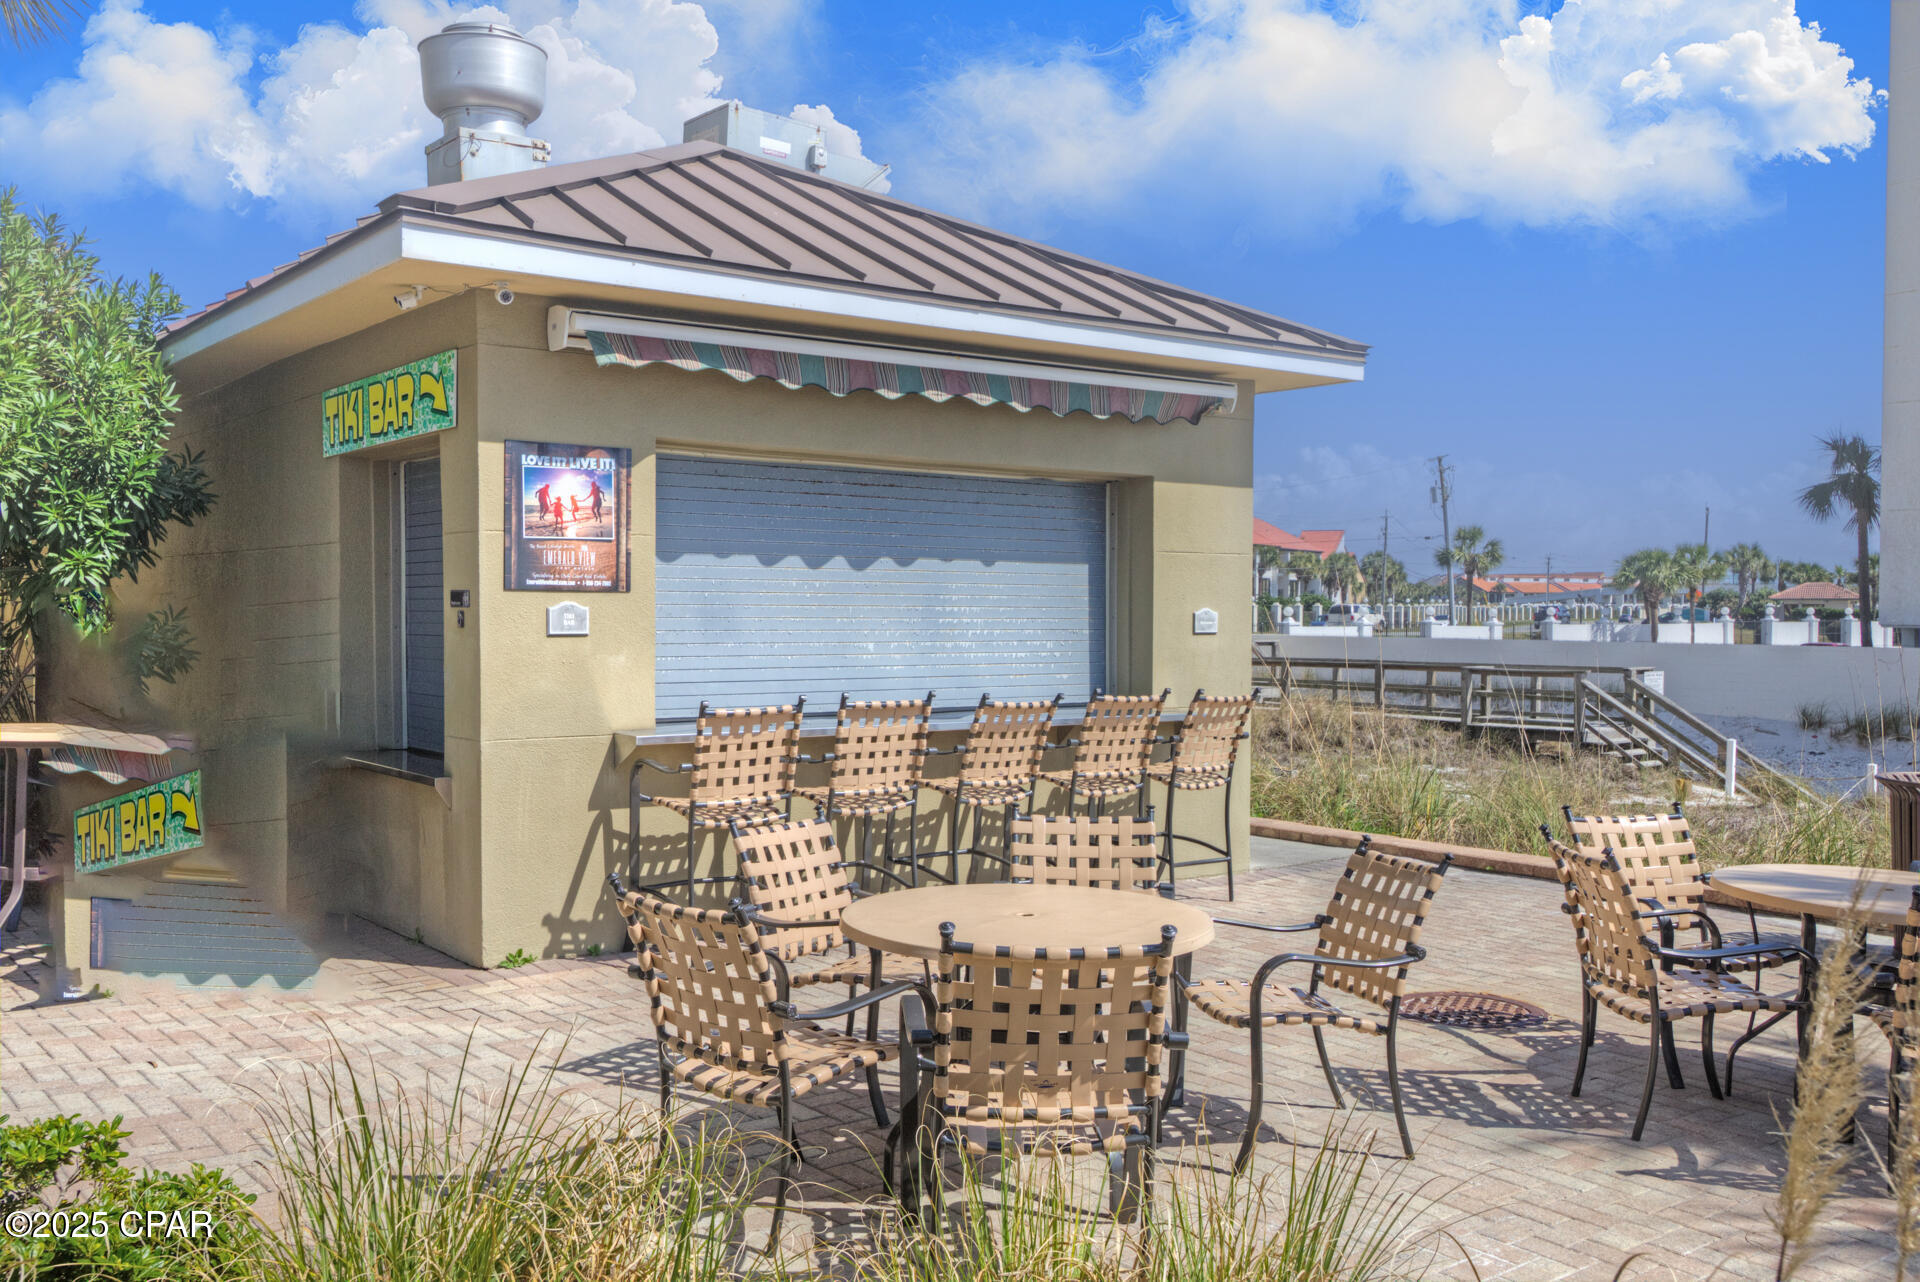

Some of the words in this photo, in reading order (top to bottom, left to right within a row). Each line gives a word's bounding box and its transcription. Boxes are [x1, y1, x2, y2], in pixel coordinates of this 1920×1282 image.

[325, 386, 364, 447] TIKI
[368, 372, 415, 437] BAR
[521, 454, 551, 467] LOVE
[552, 455, 567, 467] IT?
[569, 456, 598, 470] LIVE
[599, 457, 616, 472] IT!
[543, 550, 575, 566] EMERALD
[578, 551, 596, 567] VIEW
[76, 804, 115, 866] TIKI
[120, 790, 166, 856] BAR
